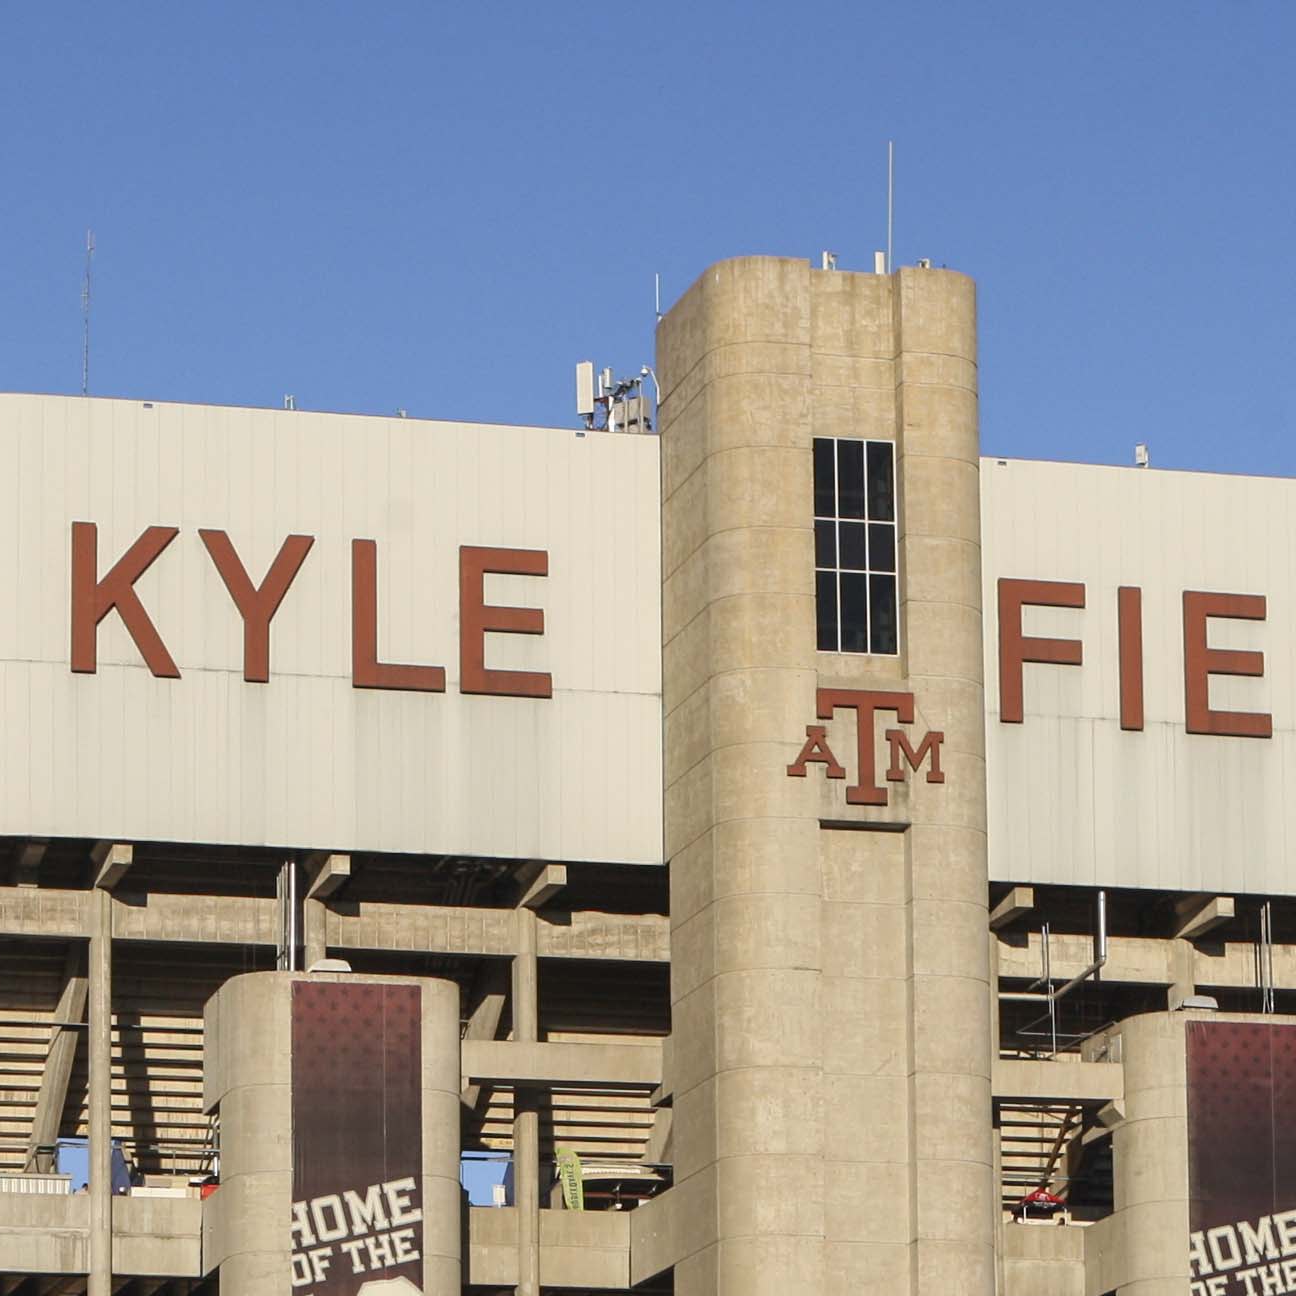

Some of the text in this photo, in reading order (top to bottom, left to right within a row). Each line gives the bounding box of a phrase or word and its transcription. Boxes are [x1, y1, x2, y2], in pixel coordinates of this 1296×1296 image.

[71, 521, 552, 699] KYLE
[291, 1177, 423, 1249] HOME
[291, 1228, 421, 1287] OF THE
